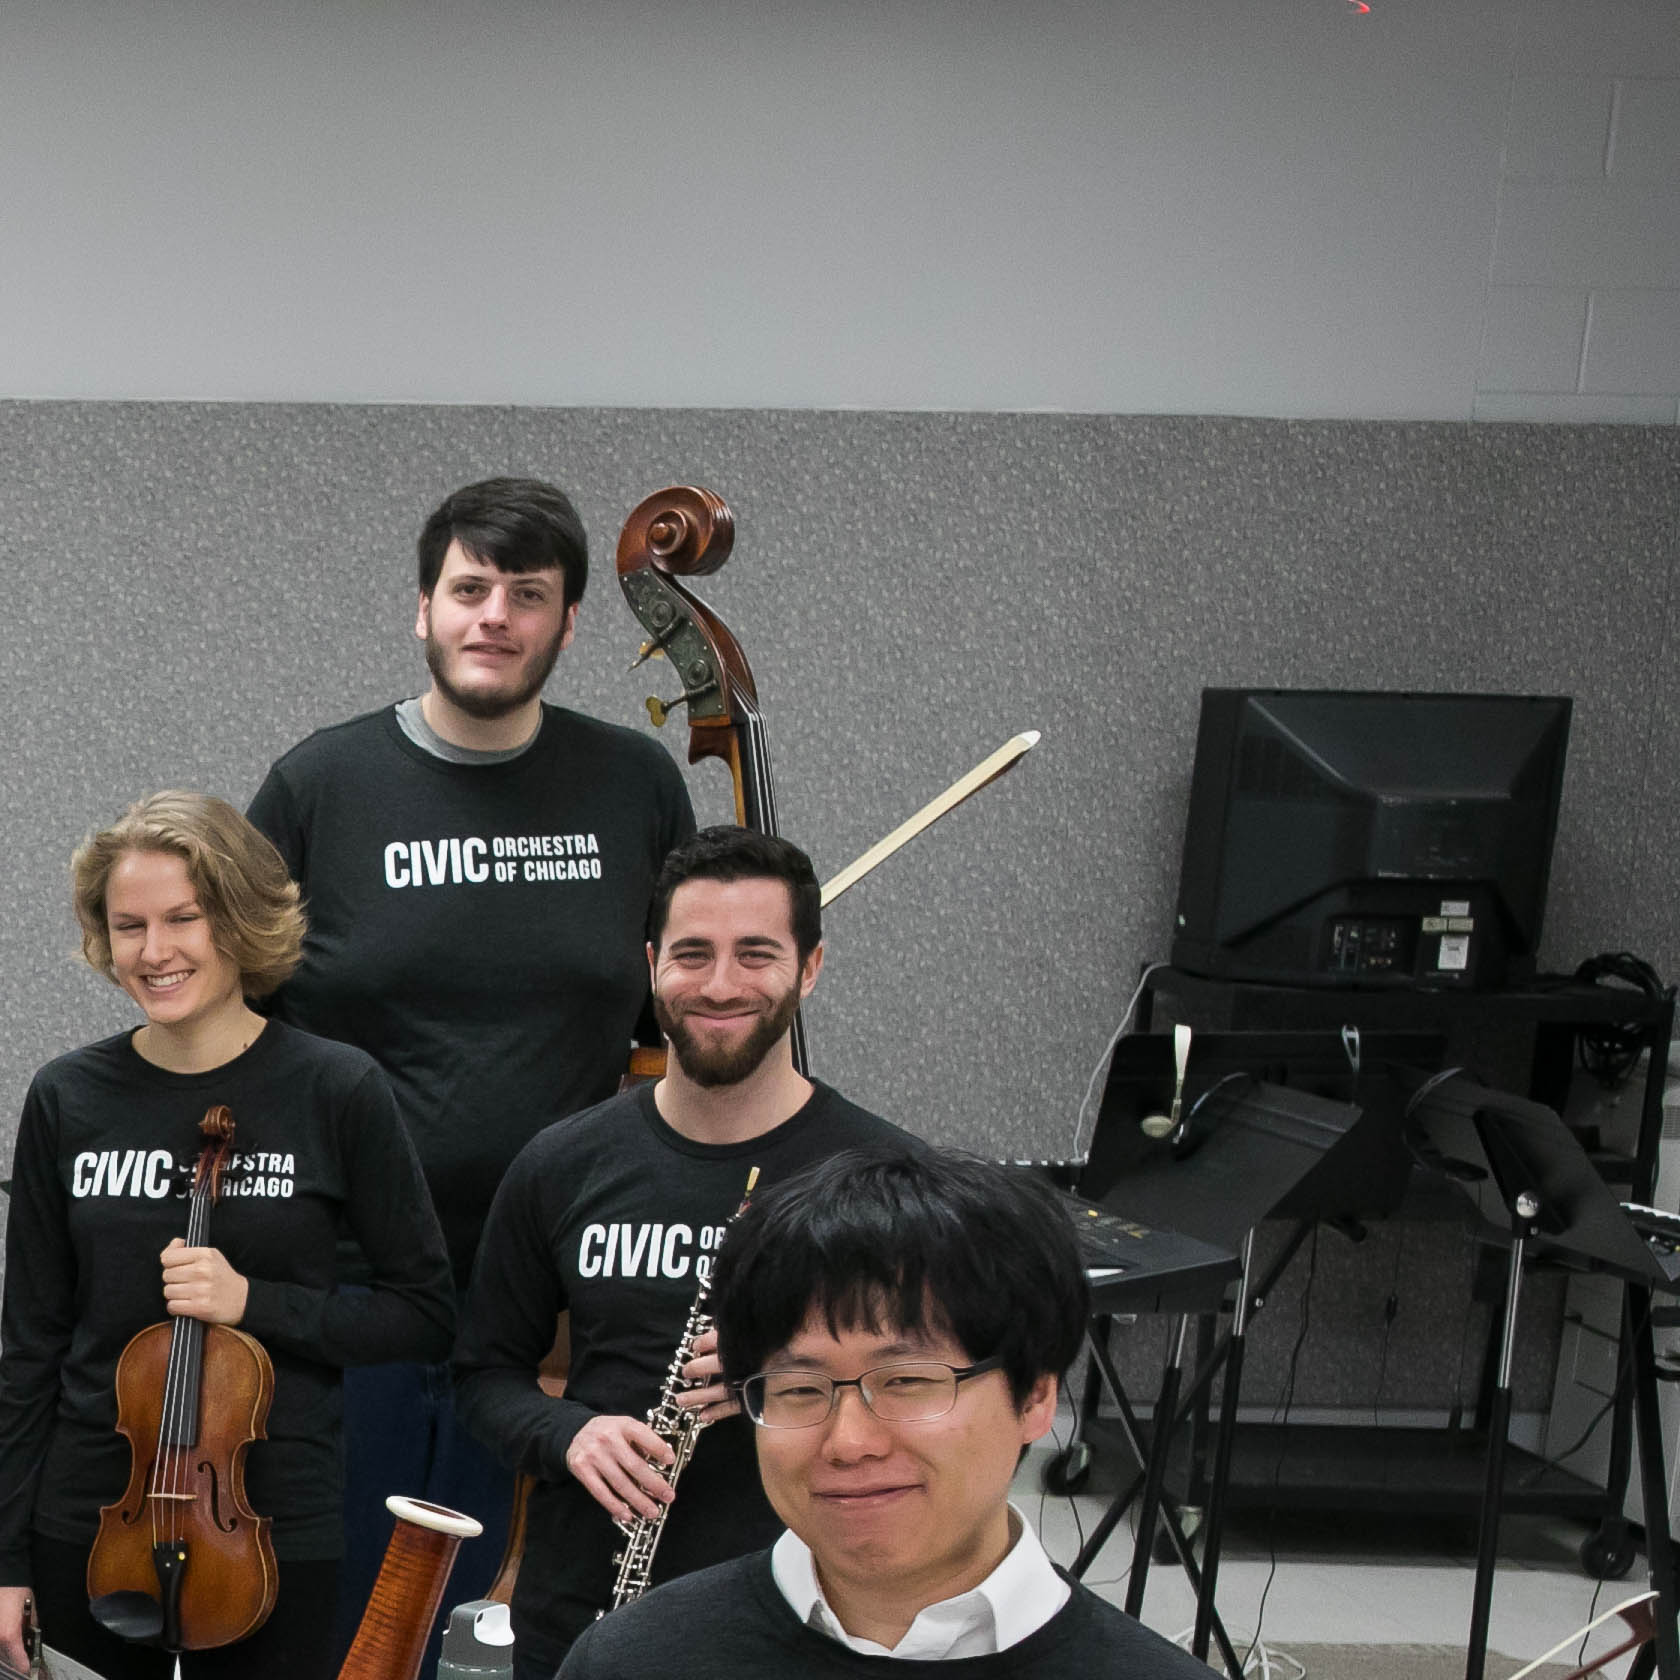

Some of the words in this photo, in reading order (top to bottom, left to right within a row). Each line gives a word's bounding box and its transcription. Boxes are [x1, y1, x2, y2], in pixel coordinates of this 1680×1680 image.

[384, 837, 489, 889] CIVIC
[493, 833, 599, 858] ORCHESTRA
[494, 861, 517, 883] OF
[523, 858, 602, 882] CHICAGO
[72, 1149, 173, 1198] CIVIC
[221, 1176, 294, 1198] HICAGO
[578, 1223, 693, 1278] CIVIC
